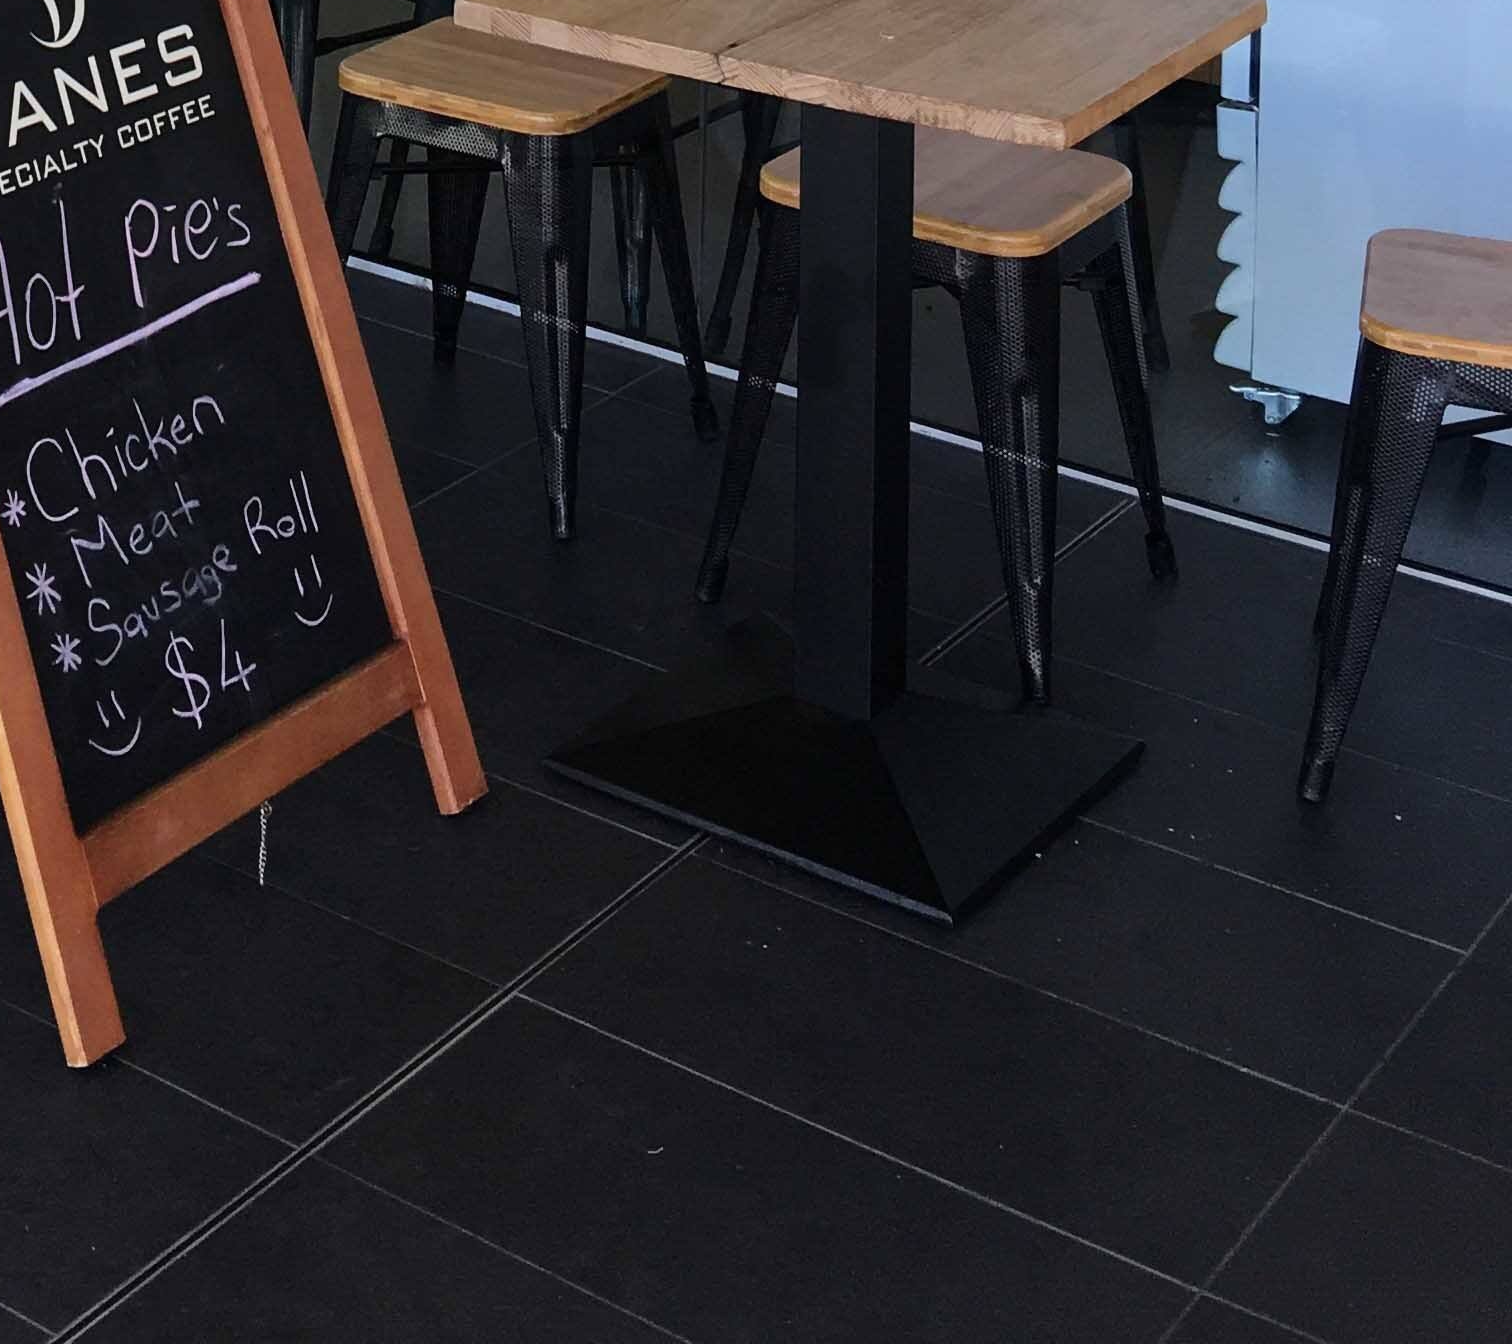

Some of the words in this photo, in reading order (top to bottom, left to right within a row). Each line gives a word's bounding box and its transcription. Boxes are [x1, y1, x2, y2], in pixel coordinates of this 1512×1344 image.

[117, 95, 216, 149] COFFEE
[26, 395, 226, 522] Chicken
[70, 481, 200, 589] Meat
[88, 544, 238, 666] Sausage
[244, 470, 319, 555] Roll
[165, 618, 256, 729] $4
